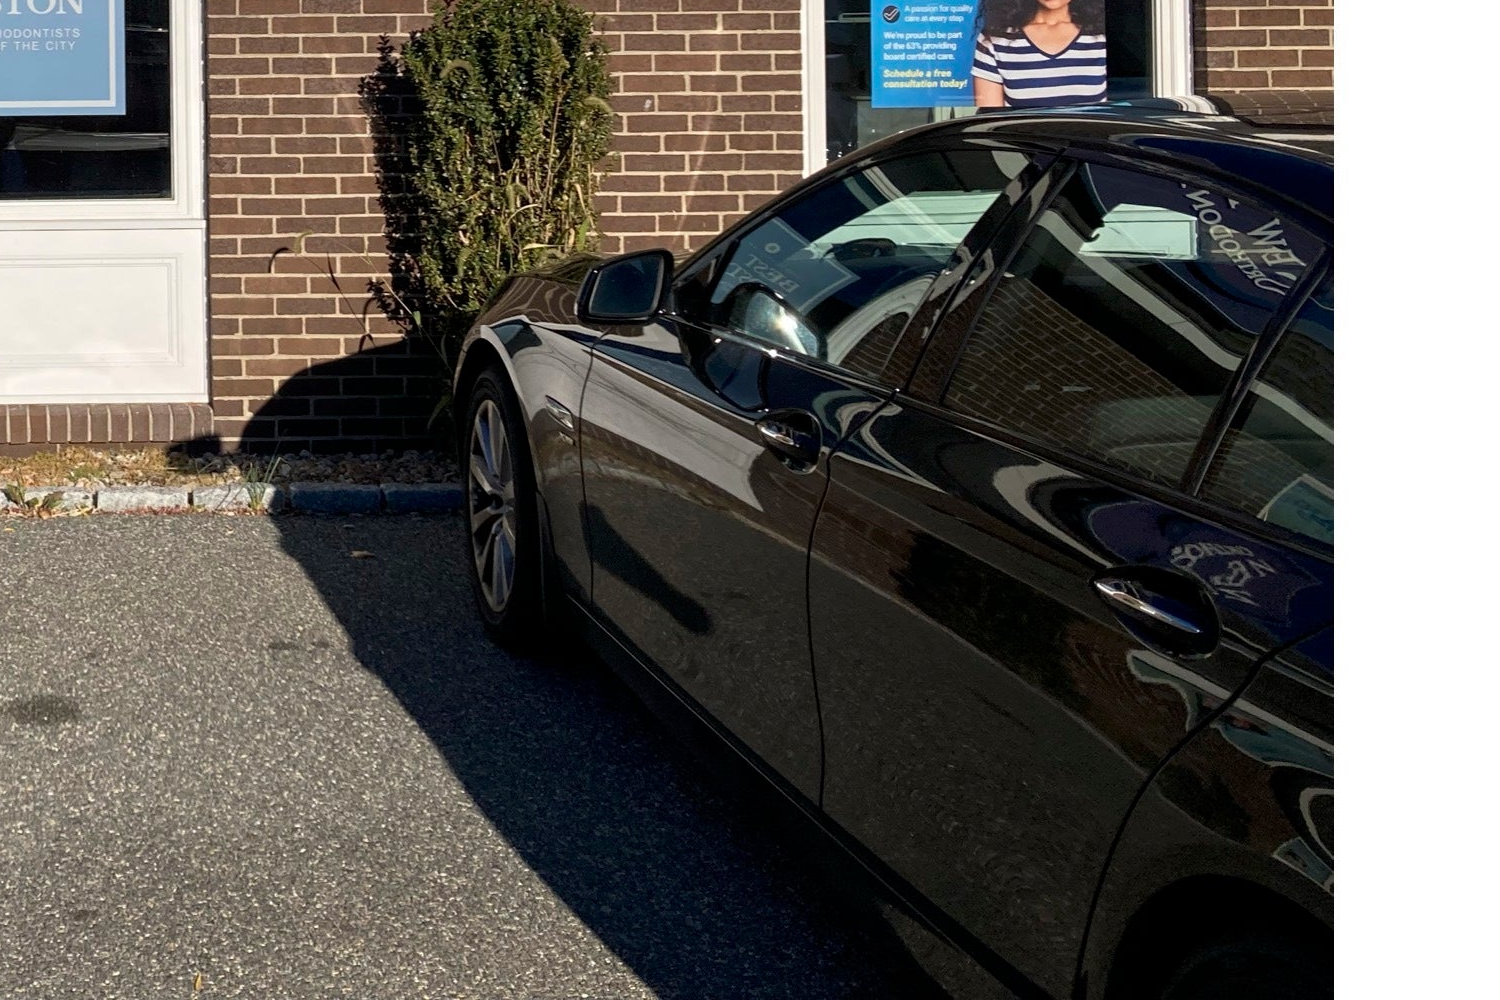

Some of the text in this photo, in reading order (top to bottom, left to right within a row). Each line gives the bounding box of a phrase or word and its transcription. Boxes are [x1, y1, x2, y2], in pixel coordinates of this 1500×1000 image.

[14, 41, 39, 51] THE
[45, 41, 76, 51] CITY
[883, 69, 923, 78] Schedule
[933, 69, 952, 78] free
[883, 79, 968, 89] consultation today!
